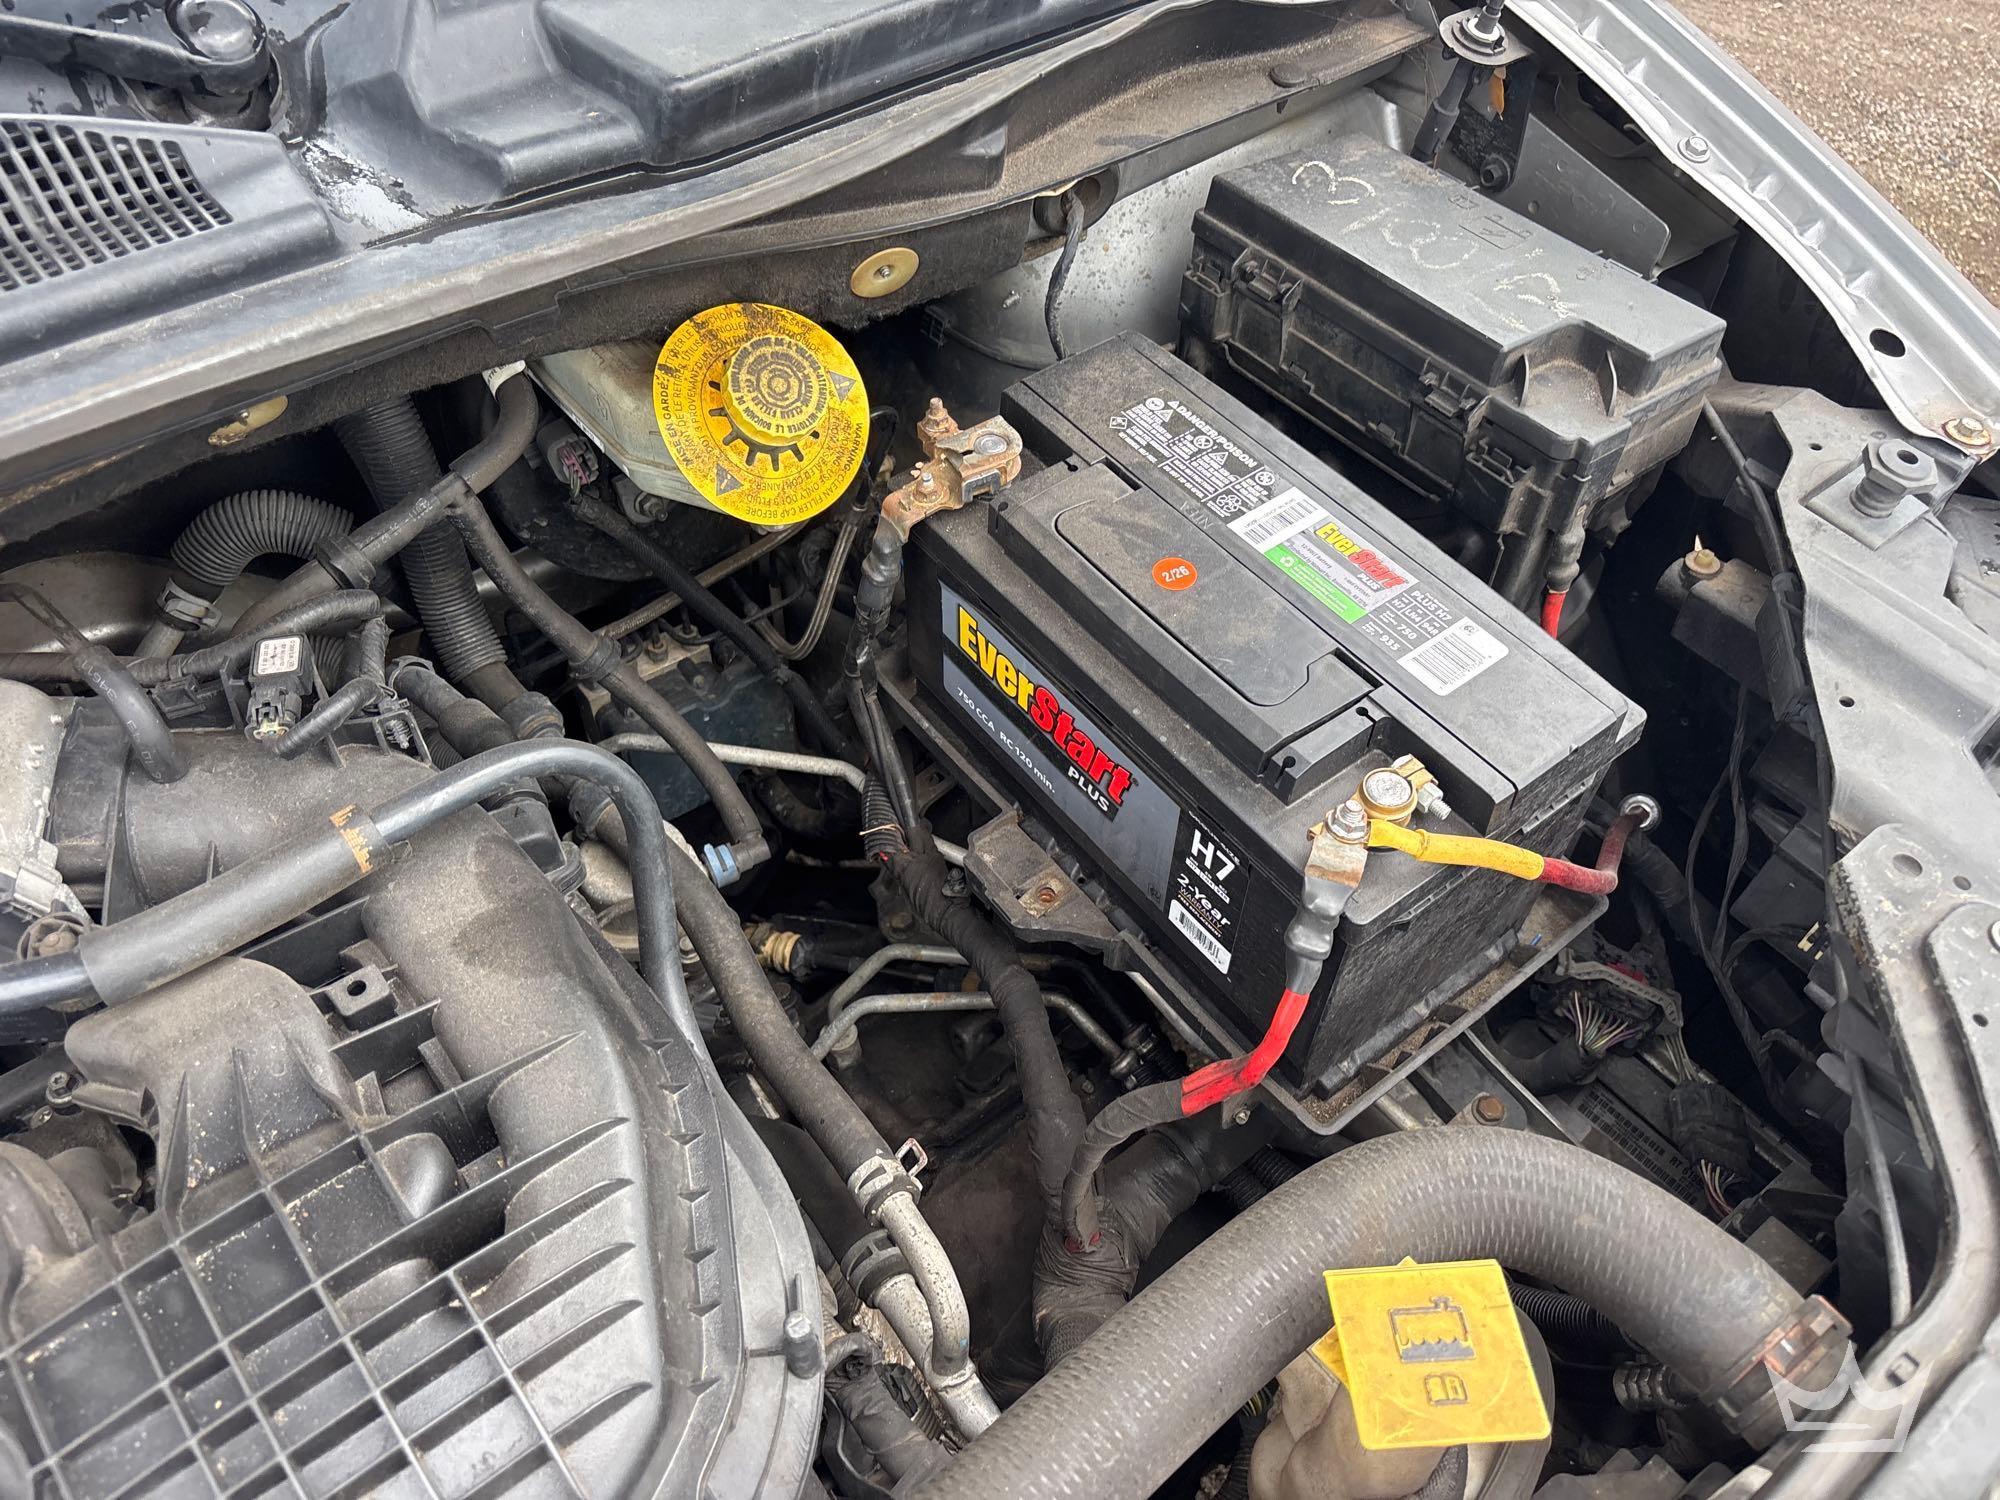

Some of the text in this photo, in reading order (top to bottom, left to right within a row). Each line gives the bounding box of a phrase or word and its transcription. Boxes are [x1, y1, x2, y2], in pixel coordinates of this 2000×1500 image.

[735, 394, 745, 406] DE
[665, 422, 677, 437] EN
[739, 405, 771, 430] BOUCHON
[775, 424, 784, 432] LE
[1175, 405, 1256, 467] DANGER/POISON
[745, 422, 861, 517] WARNING: CLEAN FILLER CAP BEFORE
[797, 481, 821, 499] ONLY
[1314, 522, 1406, 590] EverStart
[1161, 565, 1190, 583] 2/26
[1356, 573, 1381, 590] PLUS
[1391, 599, 1440, 635] H7 LN4 94R
[1410, 590, 1452, 622] PLUS H7
[1378, 634, 1400, 650] 935
[1395, 624, 1418, 639] 750
[958, 604, 1134, 806] EverStart
[956, 686, 1056, 793] 750 CCA RC 120 min.
[1067, 766, 1108, 813] PLUS
[1190, 828, 1236, 882] H7
[1177, 873, 1231, 926] 2-Year
[1180, 886, 1223, 929] WARRANTY
